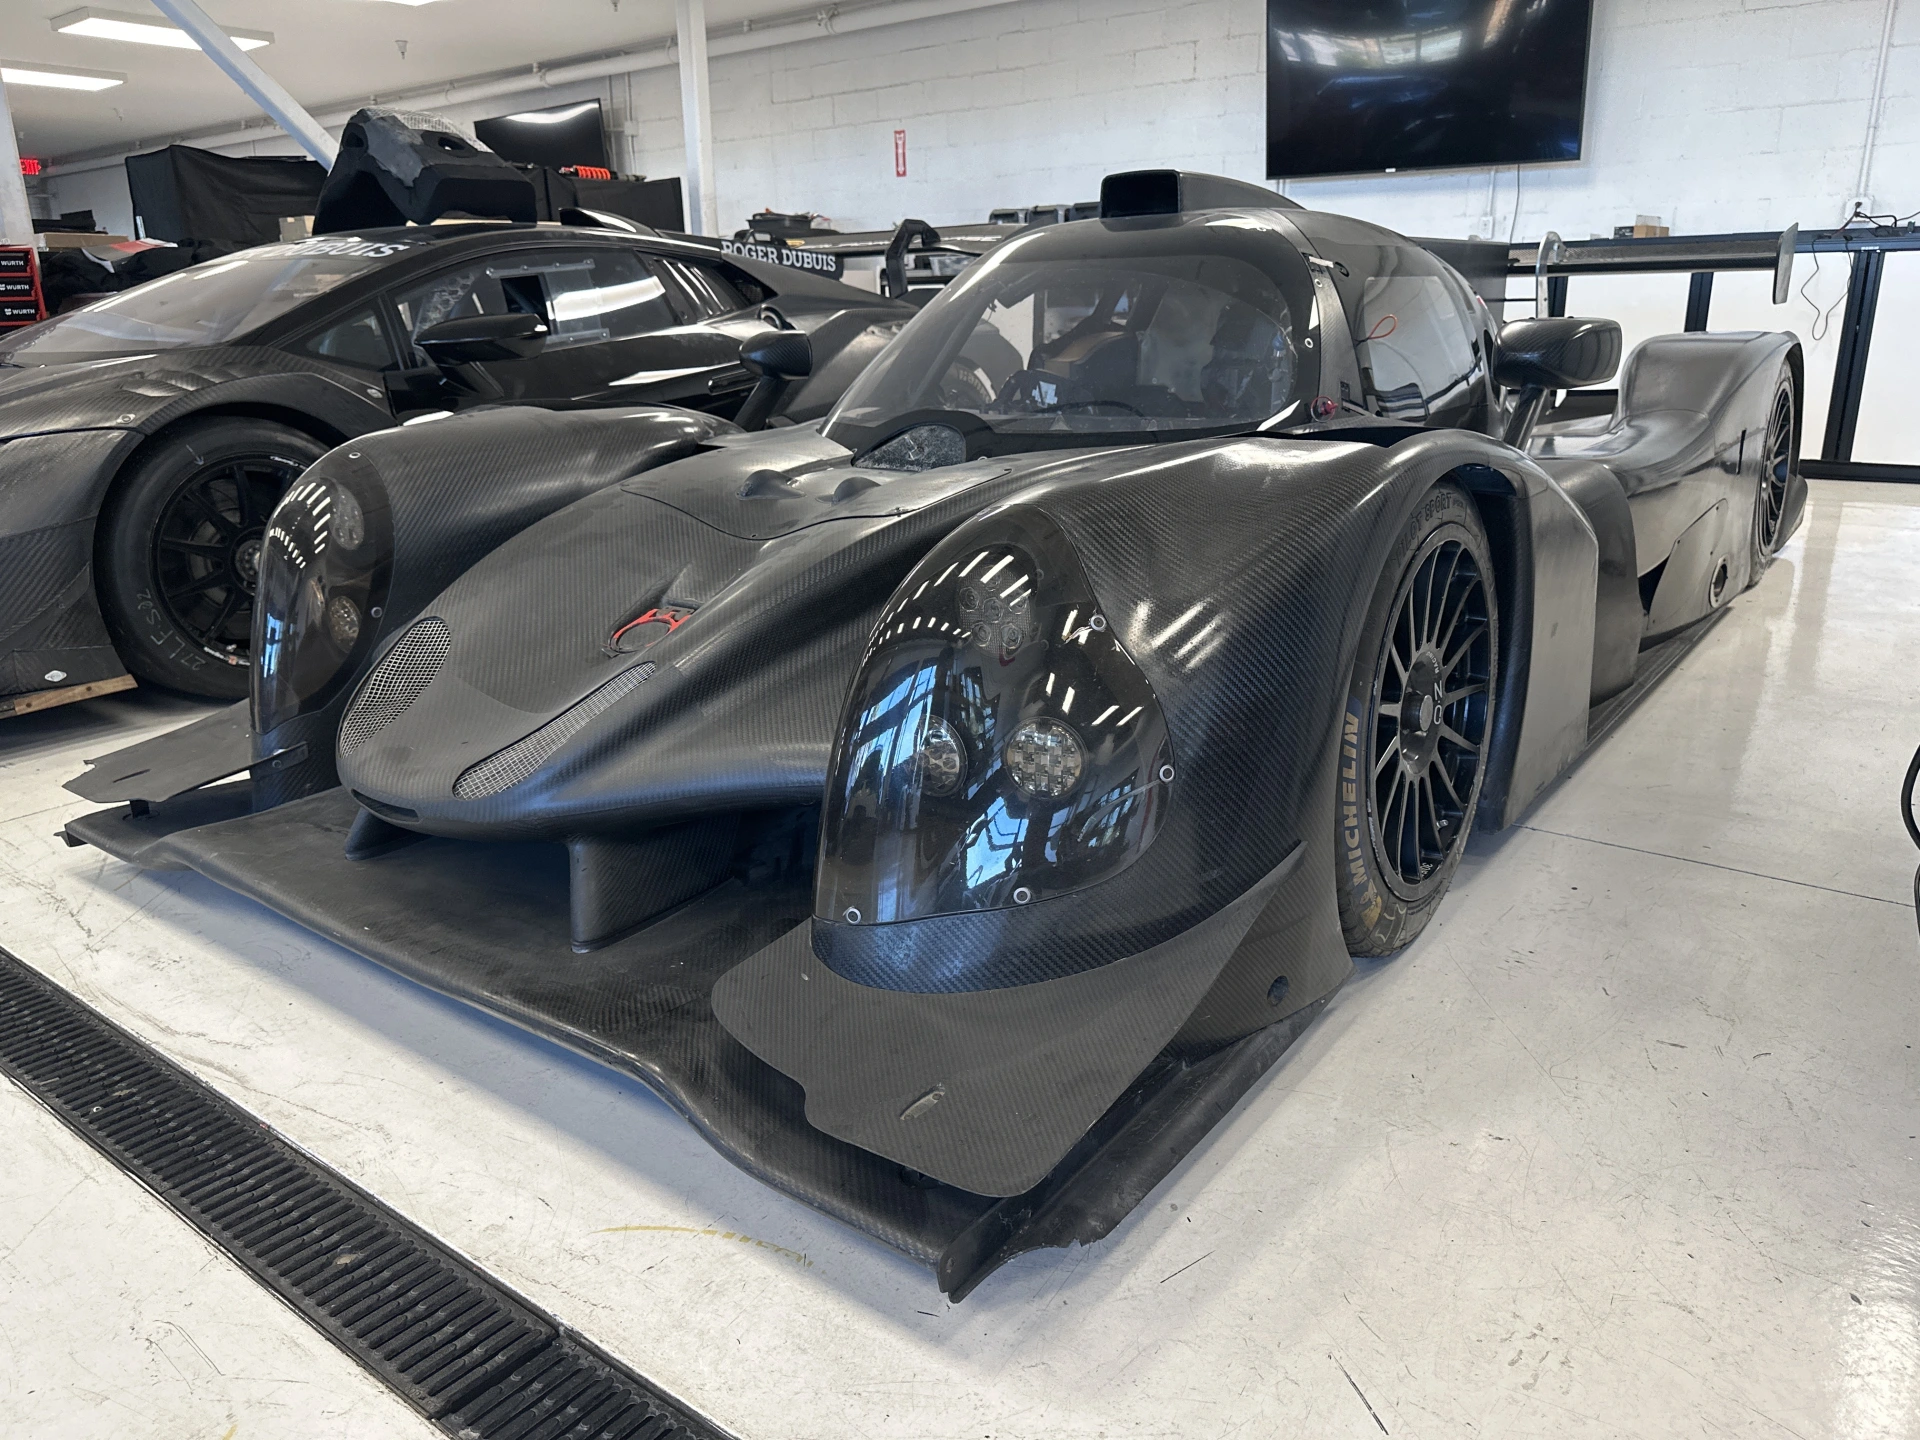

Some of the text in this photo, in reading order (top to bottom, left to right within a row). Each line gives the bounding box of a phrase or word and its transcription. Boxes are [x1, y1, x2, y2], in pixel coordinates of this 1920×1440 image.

[721, 241, 836, 272] ROGER DUBUIS
[1424, 492, 1452, 522] SPORT
[1343, 711, 1368, 887] MICHELIN
